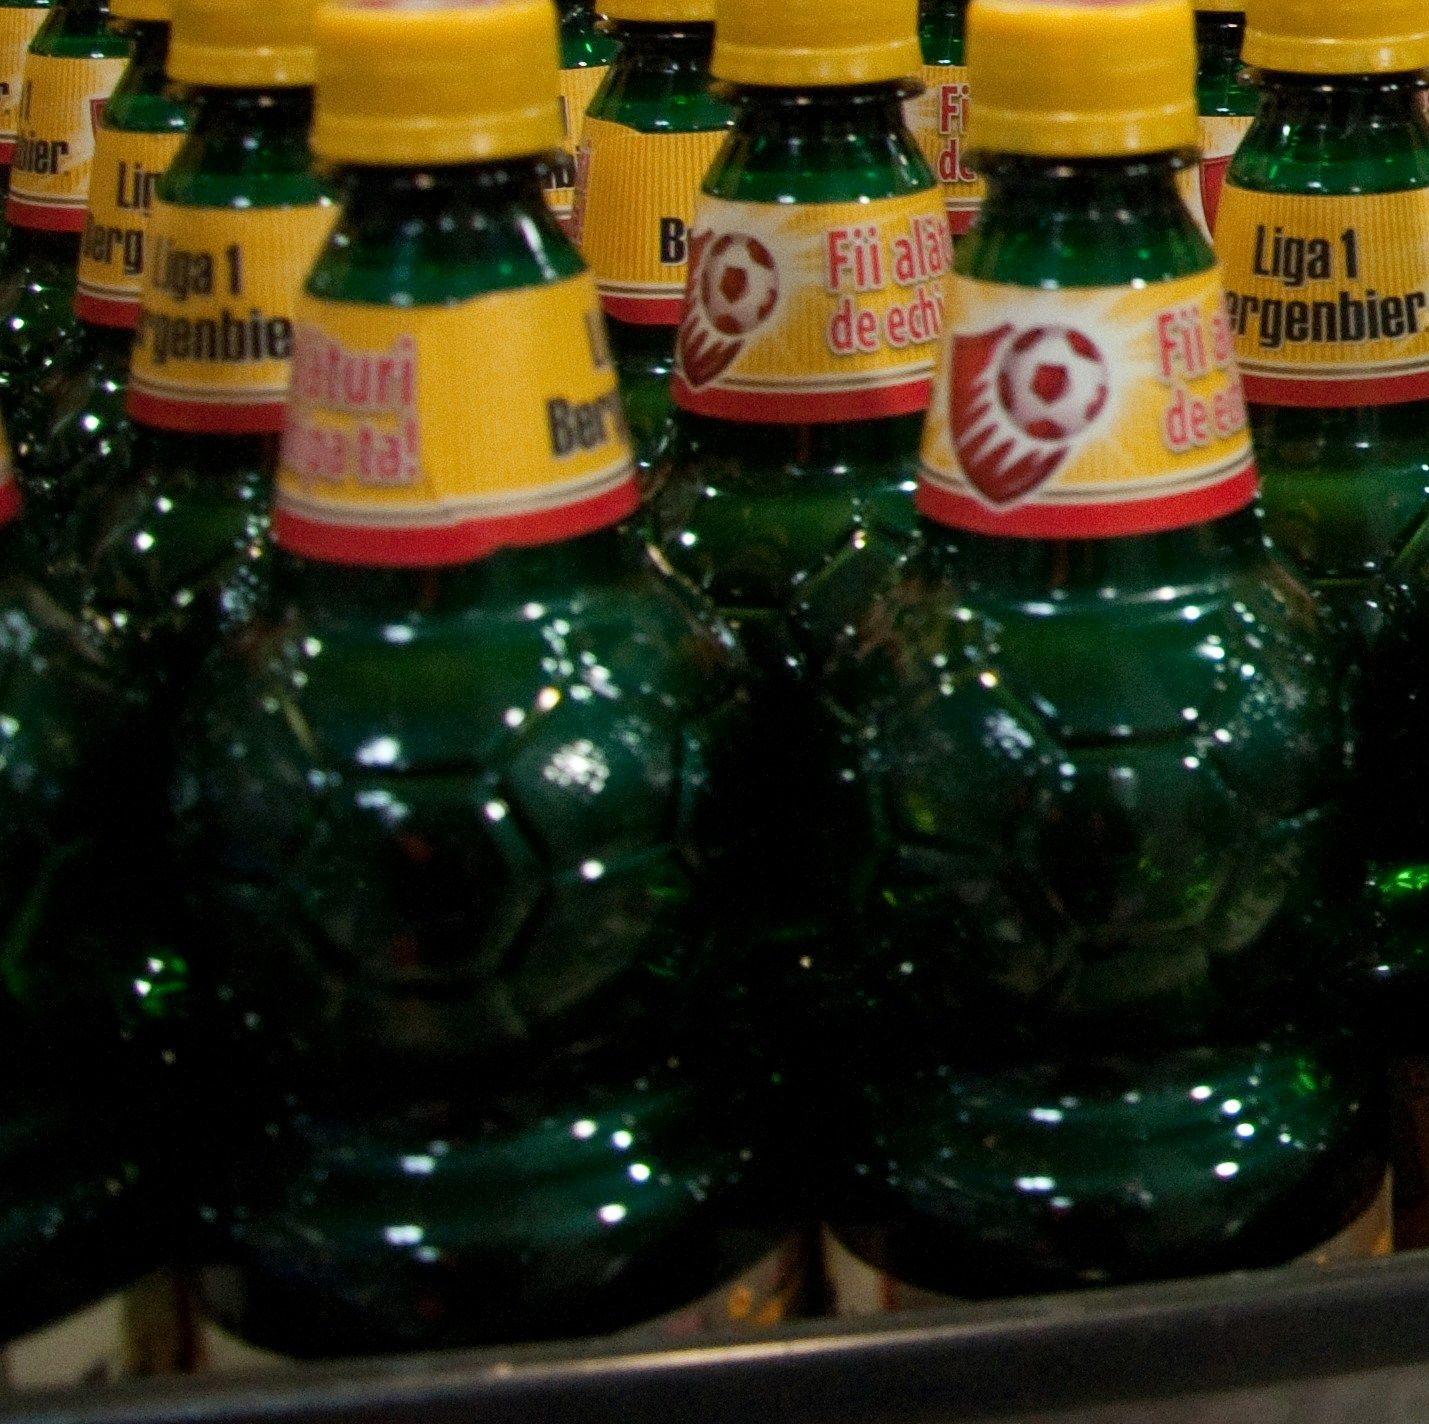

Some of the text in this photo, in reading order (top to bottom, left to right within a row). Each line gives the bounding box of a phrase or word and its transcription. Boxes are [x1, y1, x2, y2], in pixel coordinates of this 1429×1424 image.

[226, 243, 245, 298] 1
[827, 224, 883, 294] Fii
[1251, 224, 1358, 288] Liga 1
[829, 296, 878, 352] de
[1155, 304, 1209, 381] Fii
[1164, 386, 1210, 452] de
